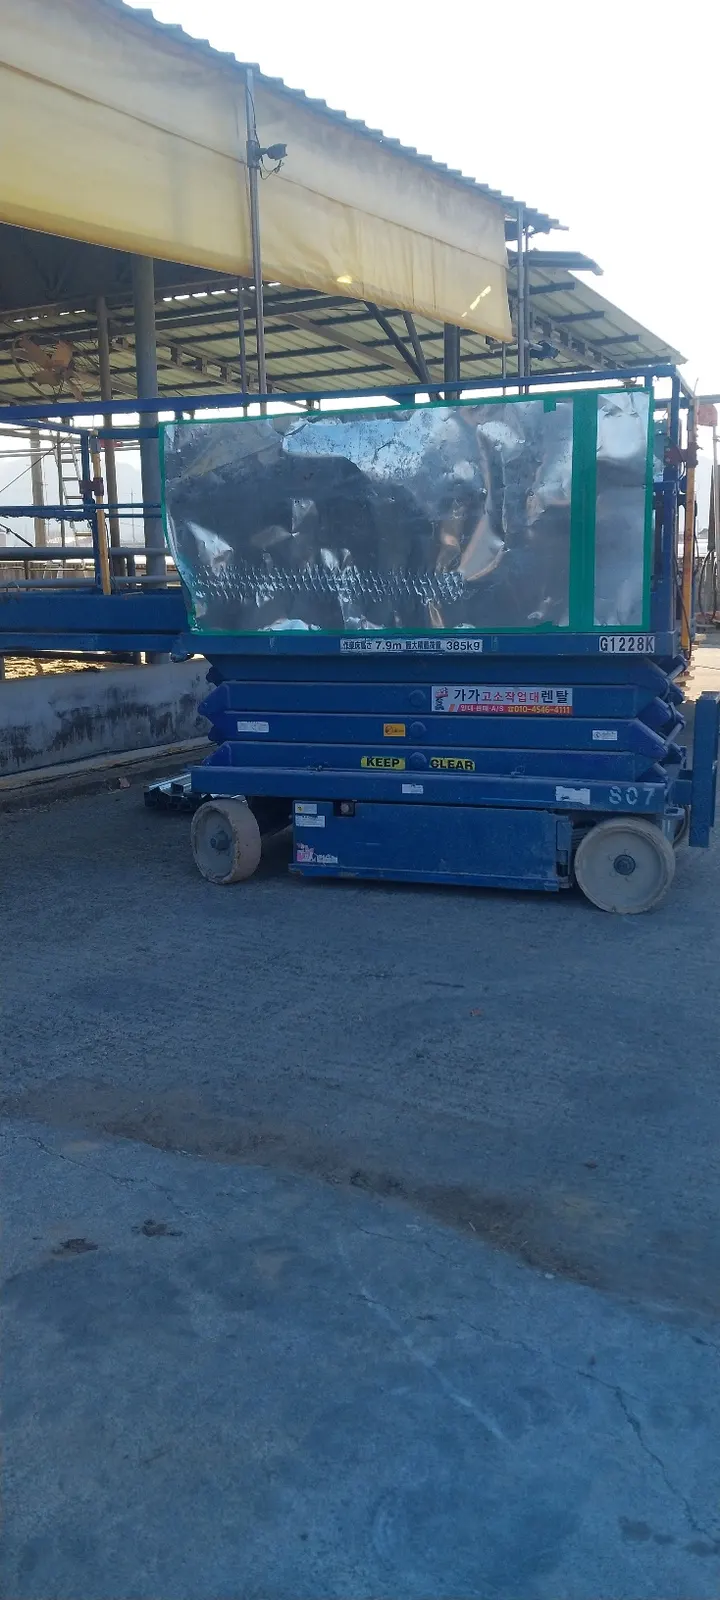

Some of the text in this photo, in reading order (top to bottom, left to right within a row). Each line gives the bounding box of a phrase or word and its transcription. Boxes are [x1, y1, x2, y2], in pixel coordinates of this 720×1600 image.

[375, 640, 402, 650] 7.9m
[446, 641, 480, 651] 385kg
[600, 637, 654, 651] G1228K
[366, 757, 474, 770] KEEP CLEAR
